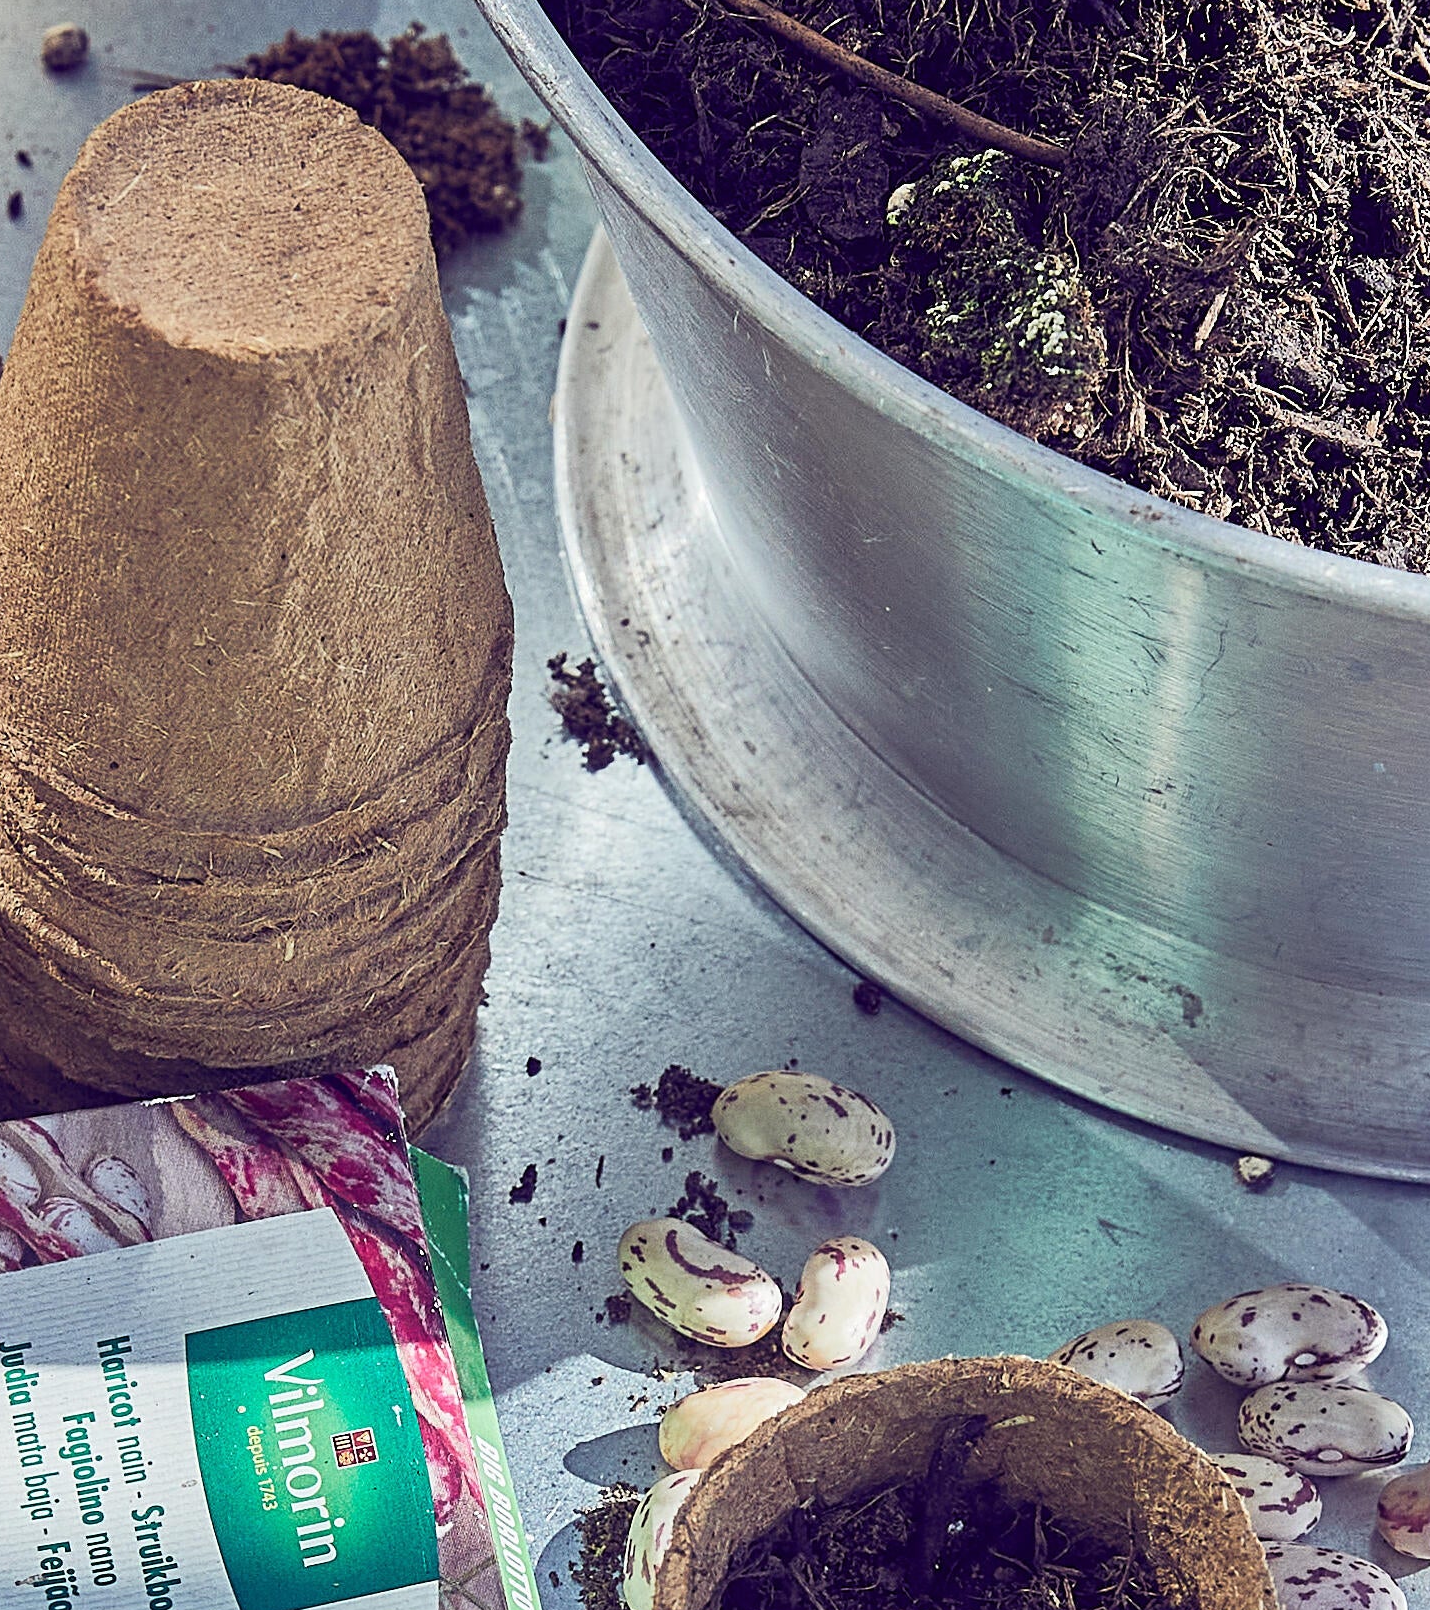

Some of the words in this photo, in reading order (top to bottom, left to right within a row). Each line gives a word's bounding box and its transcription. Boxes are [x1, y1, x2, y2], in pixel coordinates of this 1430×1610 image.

[97, 1335, 142, 1427] Haricot
[12, 1411, 46, 1468] mata
[116, 1435, 153, 1484] nain
[246, 1425, 269, 1476] depuis
[258, 1477, 278, 1511] 1743
[263, 1348, 345, 1567] Vilmorin
[475, 1434, 505, 1490] BIG
[20, 1471, 60, 1521] baja
[58, 1411, 110, 1526] Fagiolino
[85, 1531, 117, 1588] nano
